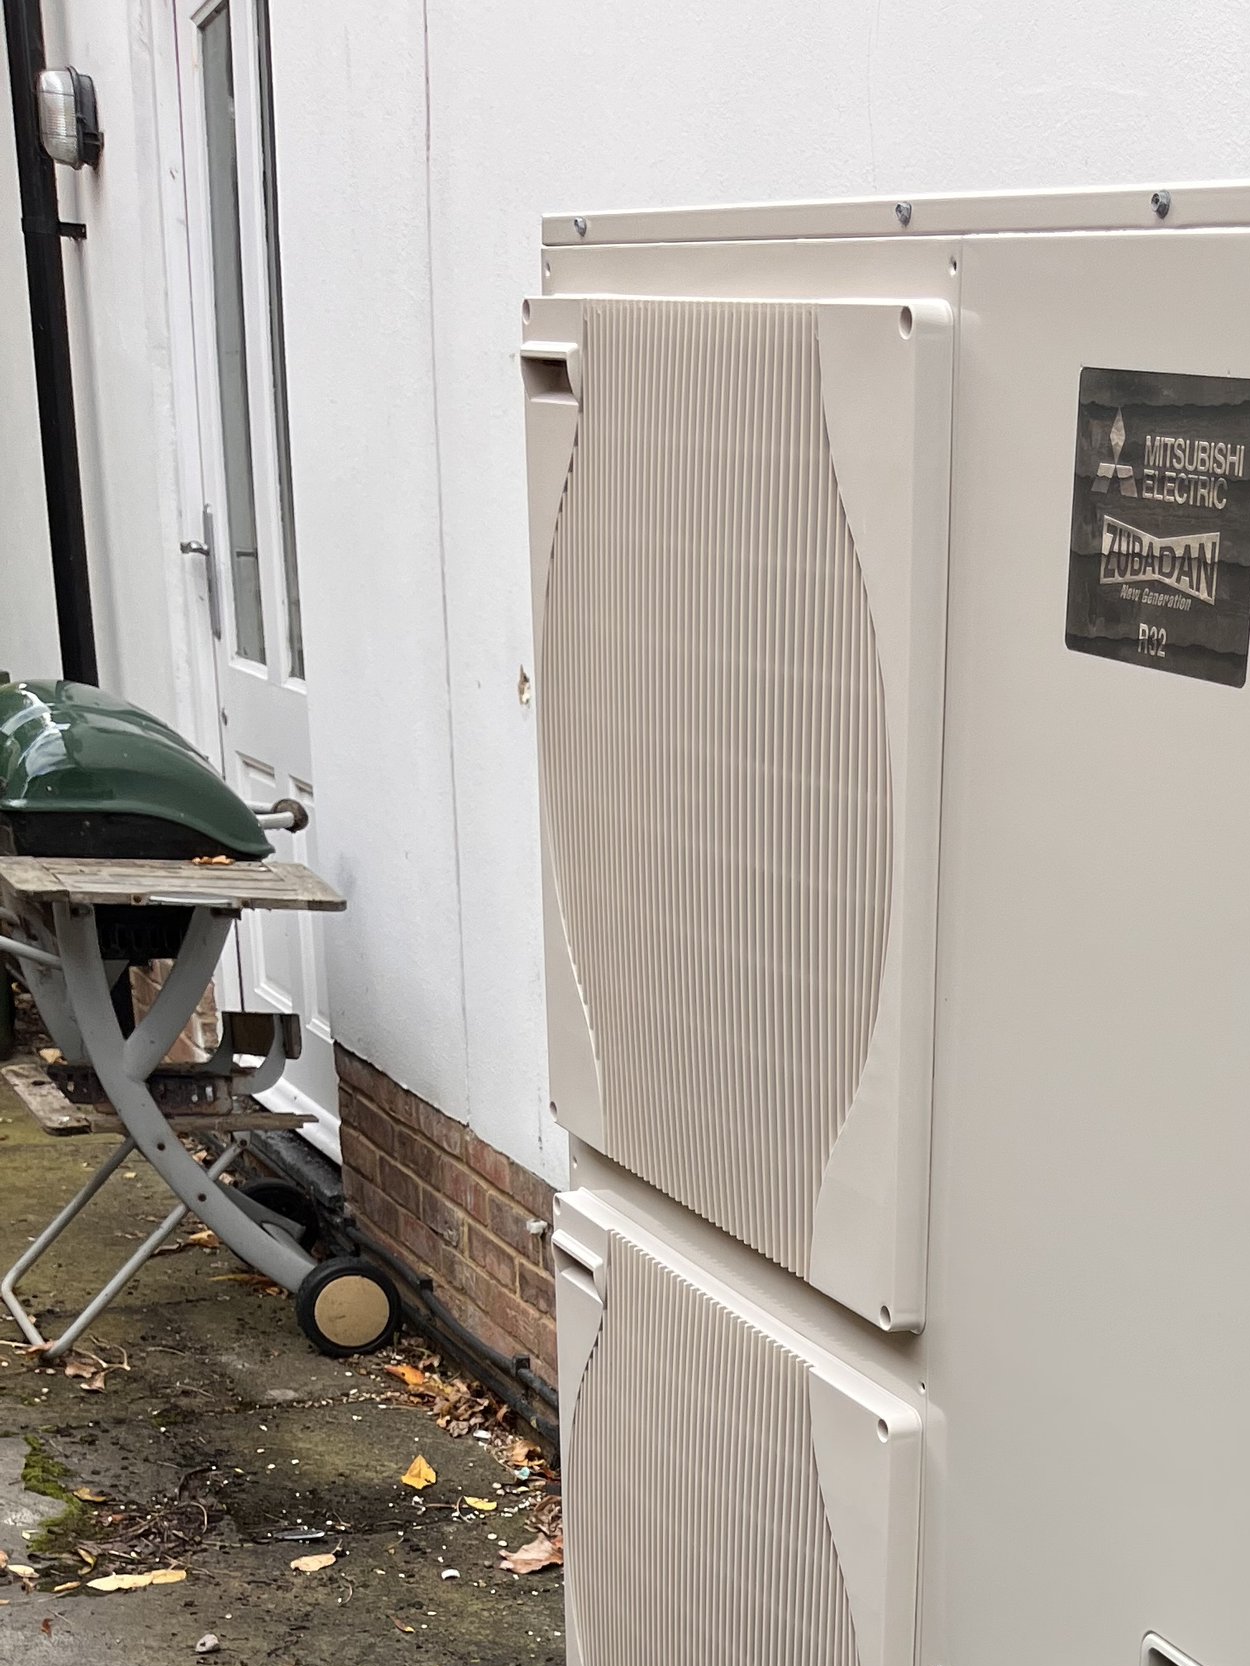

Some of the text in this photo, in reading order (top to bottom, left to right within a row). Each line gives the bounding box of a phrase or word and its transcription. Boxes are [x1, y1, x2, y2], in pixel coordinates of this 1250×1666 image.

[1144, 435, 1245, 477] MITSUBISHI
[1142, 469, 1229, 510] ELECTRIC
[1102, 521, 1217, 598] ZUBADAN
[1120, 584, 1192, 611] New Generation
[1137, 622, 1167, 658] R32
